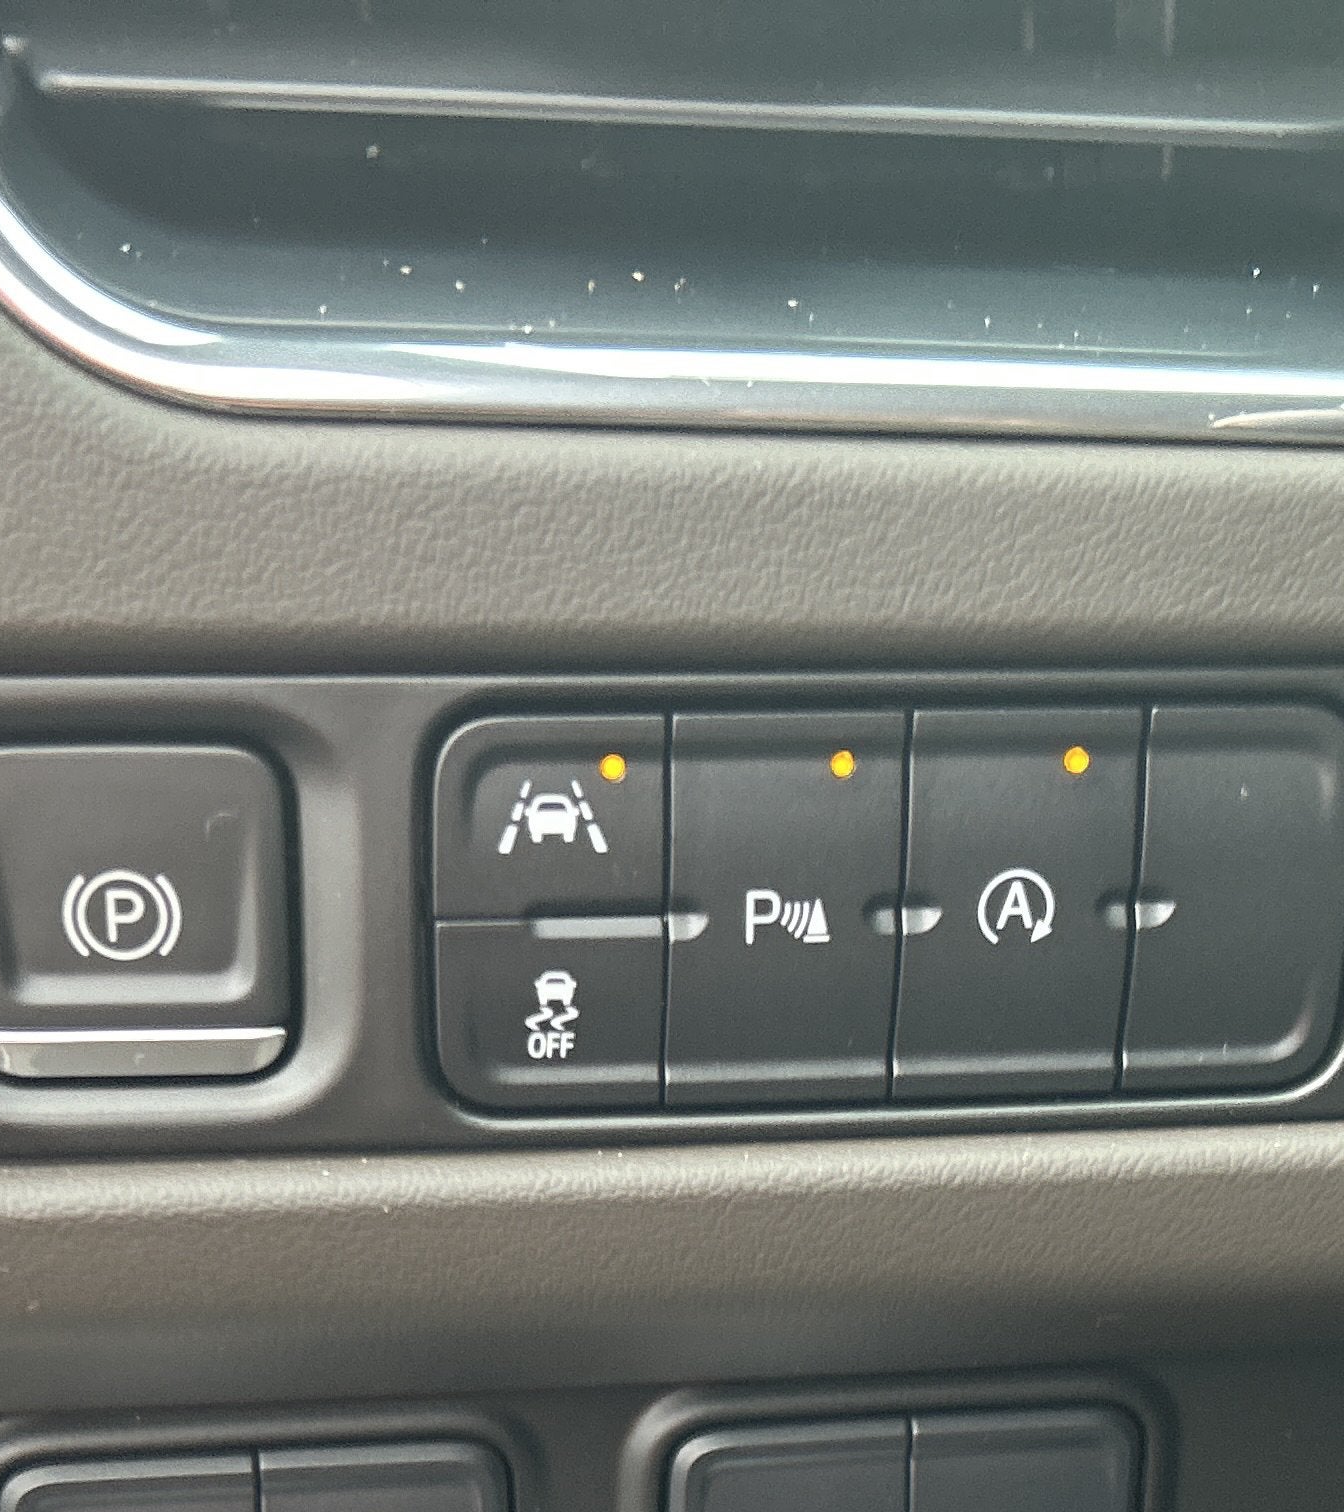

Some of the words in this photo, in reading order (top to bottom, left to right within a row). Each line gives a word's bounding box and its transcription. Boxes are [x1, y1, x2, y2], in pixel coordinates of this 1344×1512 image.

[105, 889, 145, 943] P
[744, 888, 778, 946] P
[996, 881, 1033, 931] A
[527, 1032, 576, 1059] OFF
